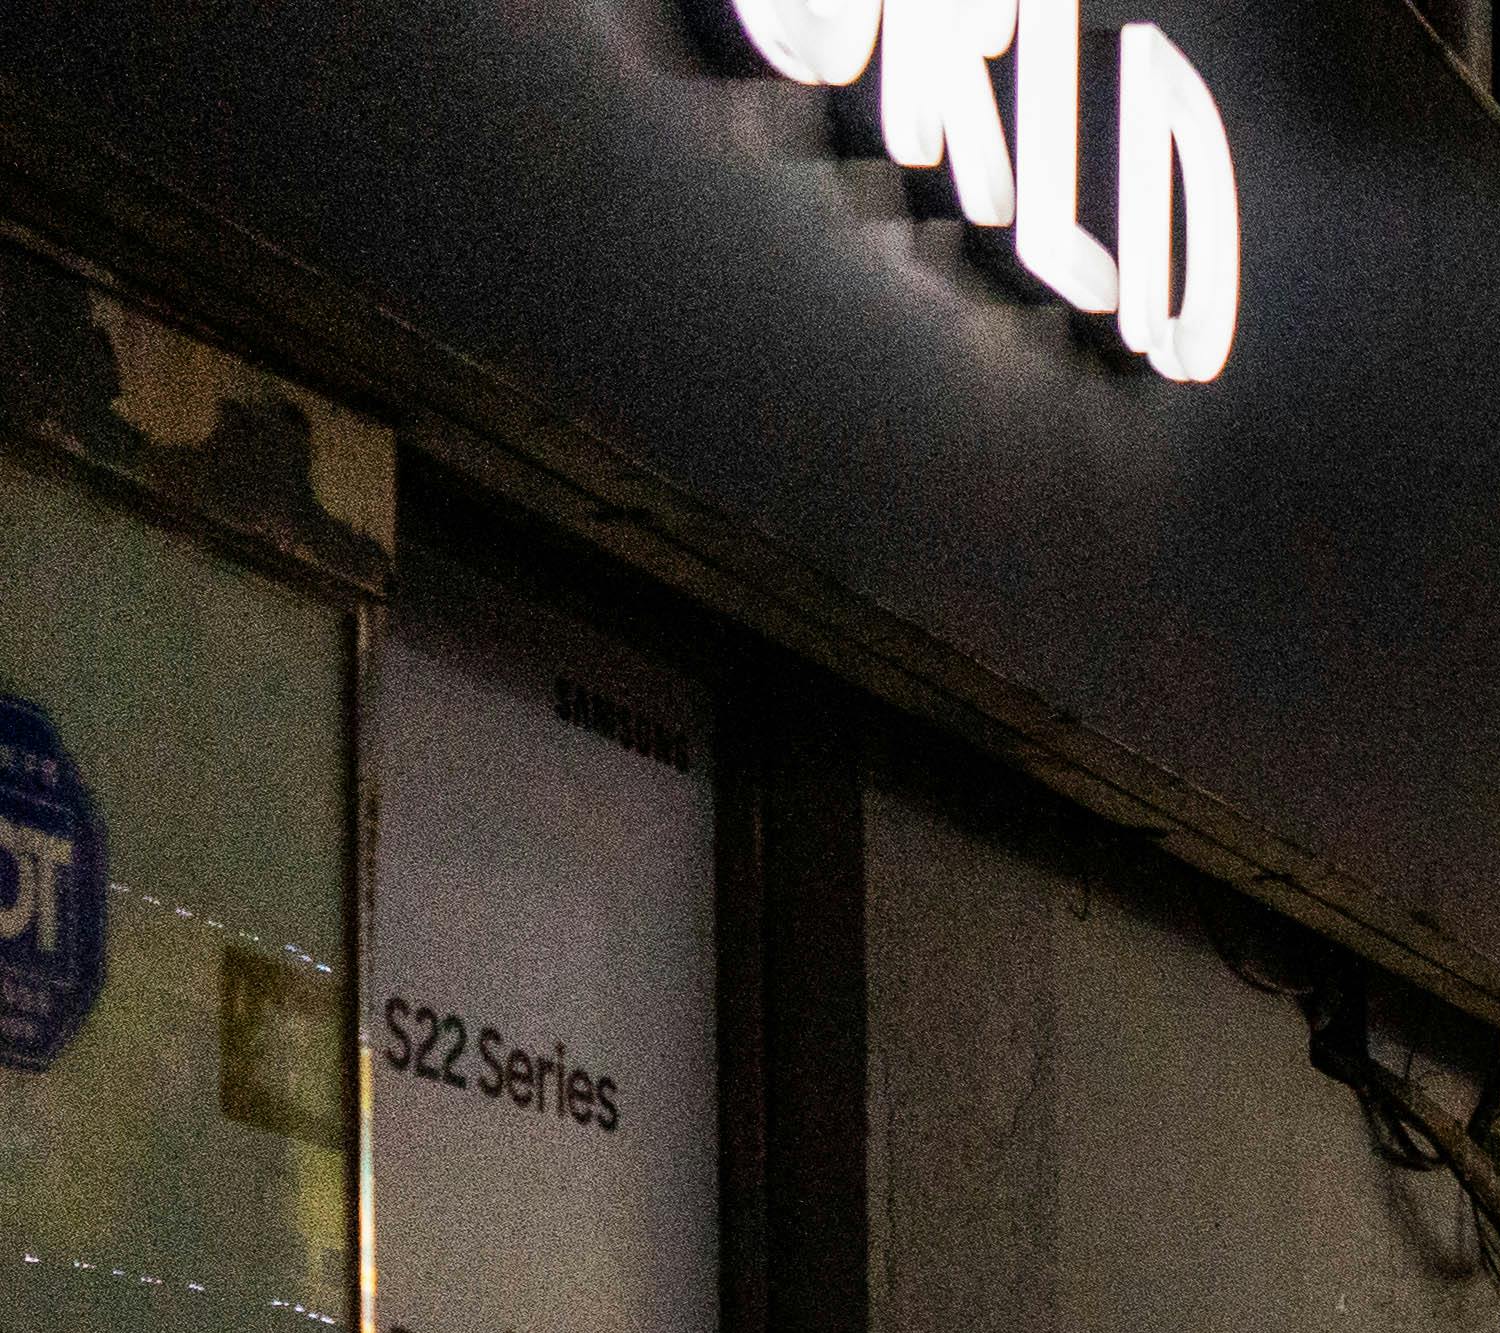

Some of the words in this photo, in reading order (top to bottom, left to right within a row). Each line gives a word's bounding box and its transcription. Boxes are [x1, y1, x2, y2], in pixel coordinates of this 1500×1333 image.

[733, 0, 1239, 382] RLD
[383, 998, 468, 1090] S22
[480, 1027, 620, 1132] Series
